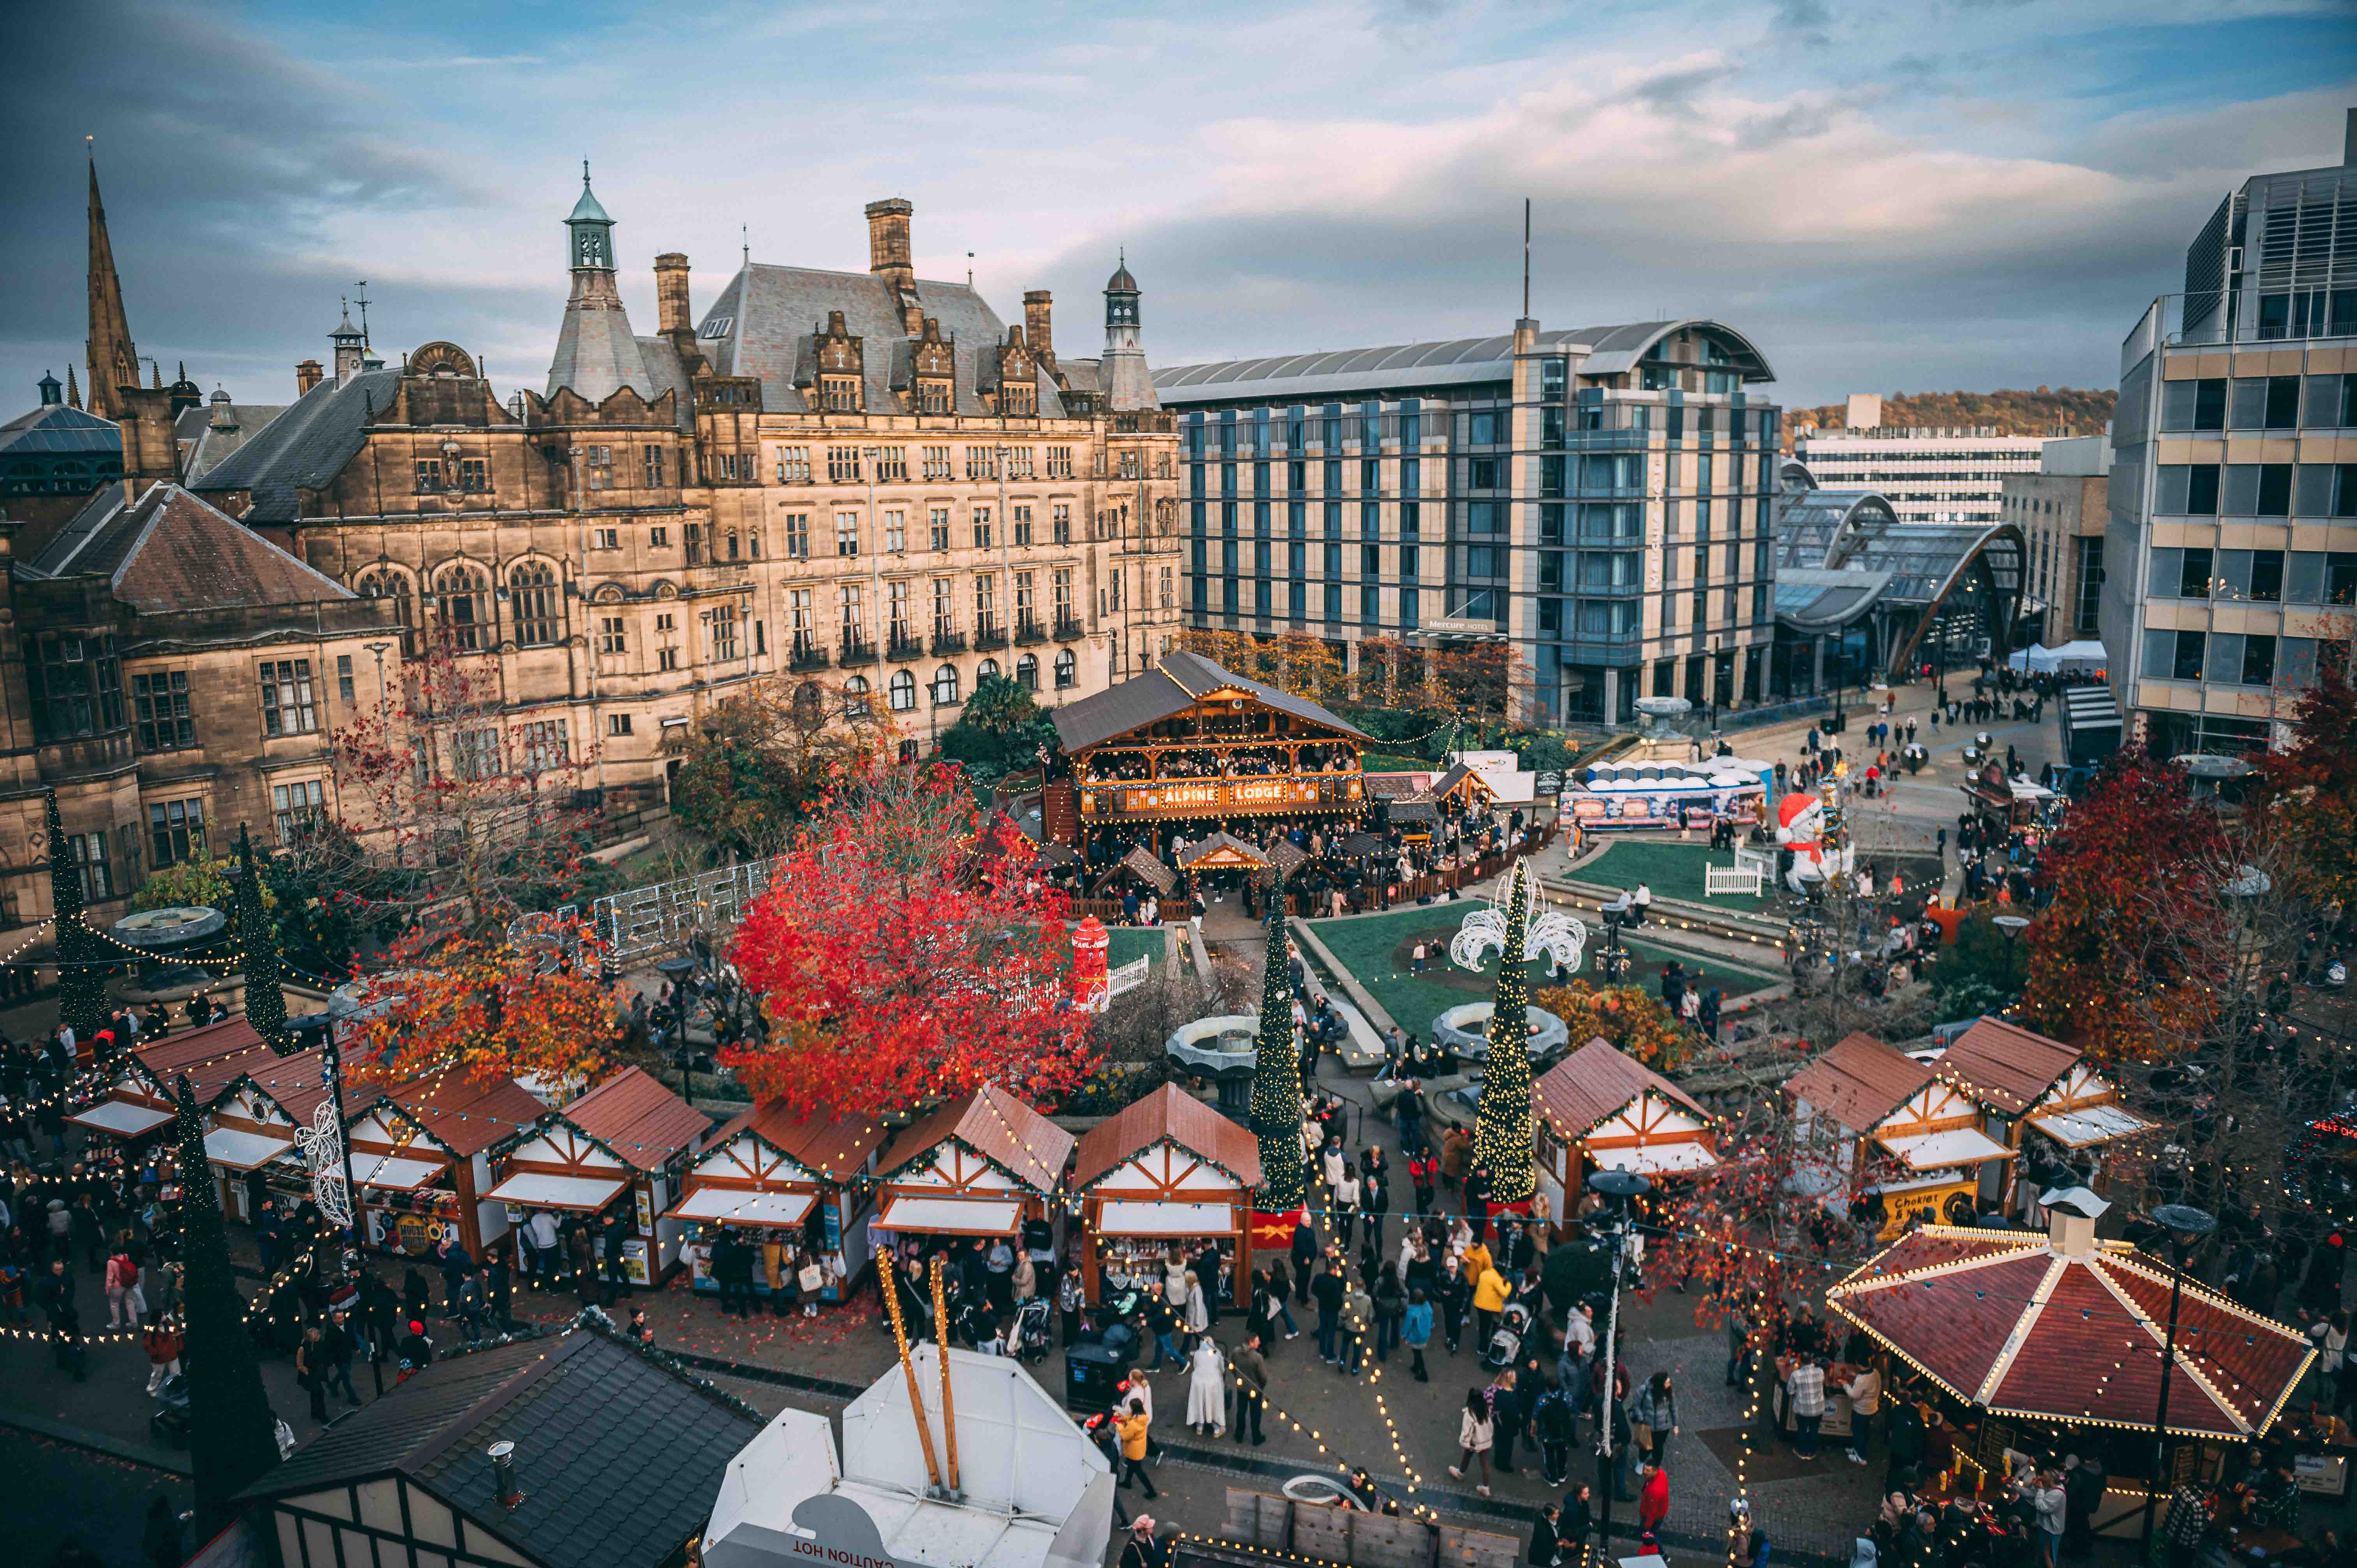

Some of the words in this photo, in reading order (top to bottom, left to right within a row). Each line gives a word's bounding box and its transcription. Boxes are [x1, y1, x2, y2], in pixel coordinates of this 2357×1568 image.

[1429, 620, 1465, 629] Mercure
[1164, 789, 1216, 803] ALPINE
[1236, 786, 1282, 799] LODGE
[793, 1540, 823, 1558] HOT
